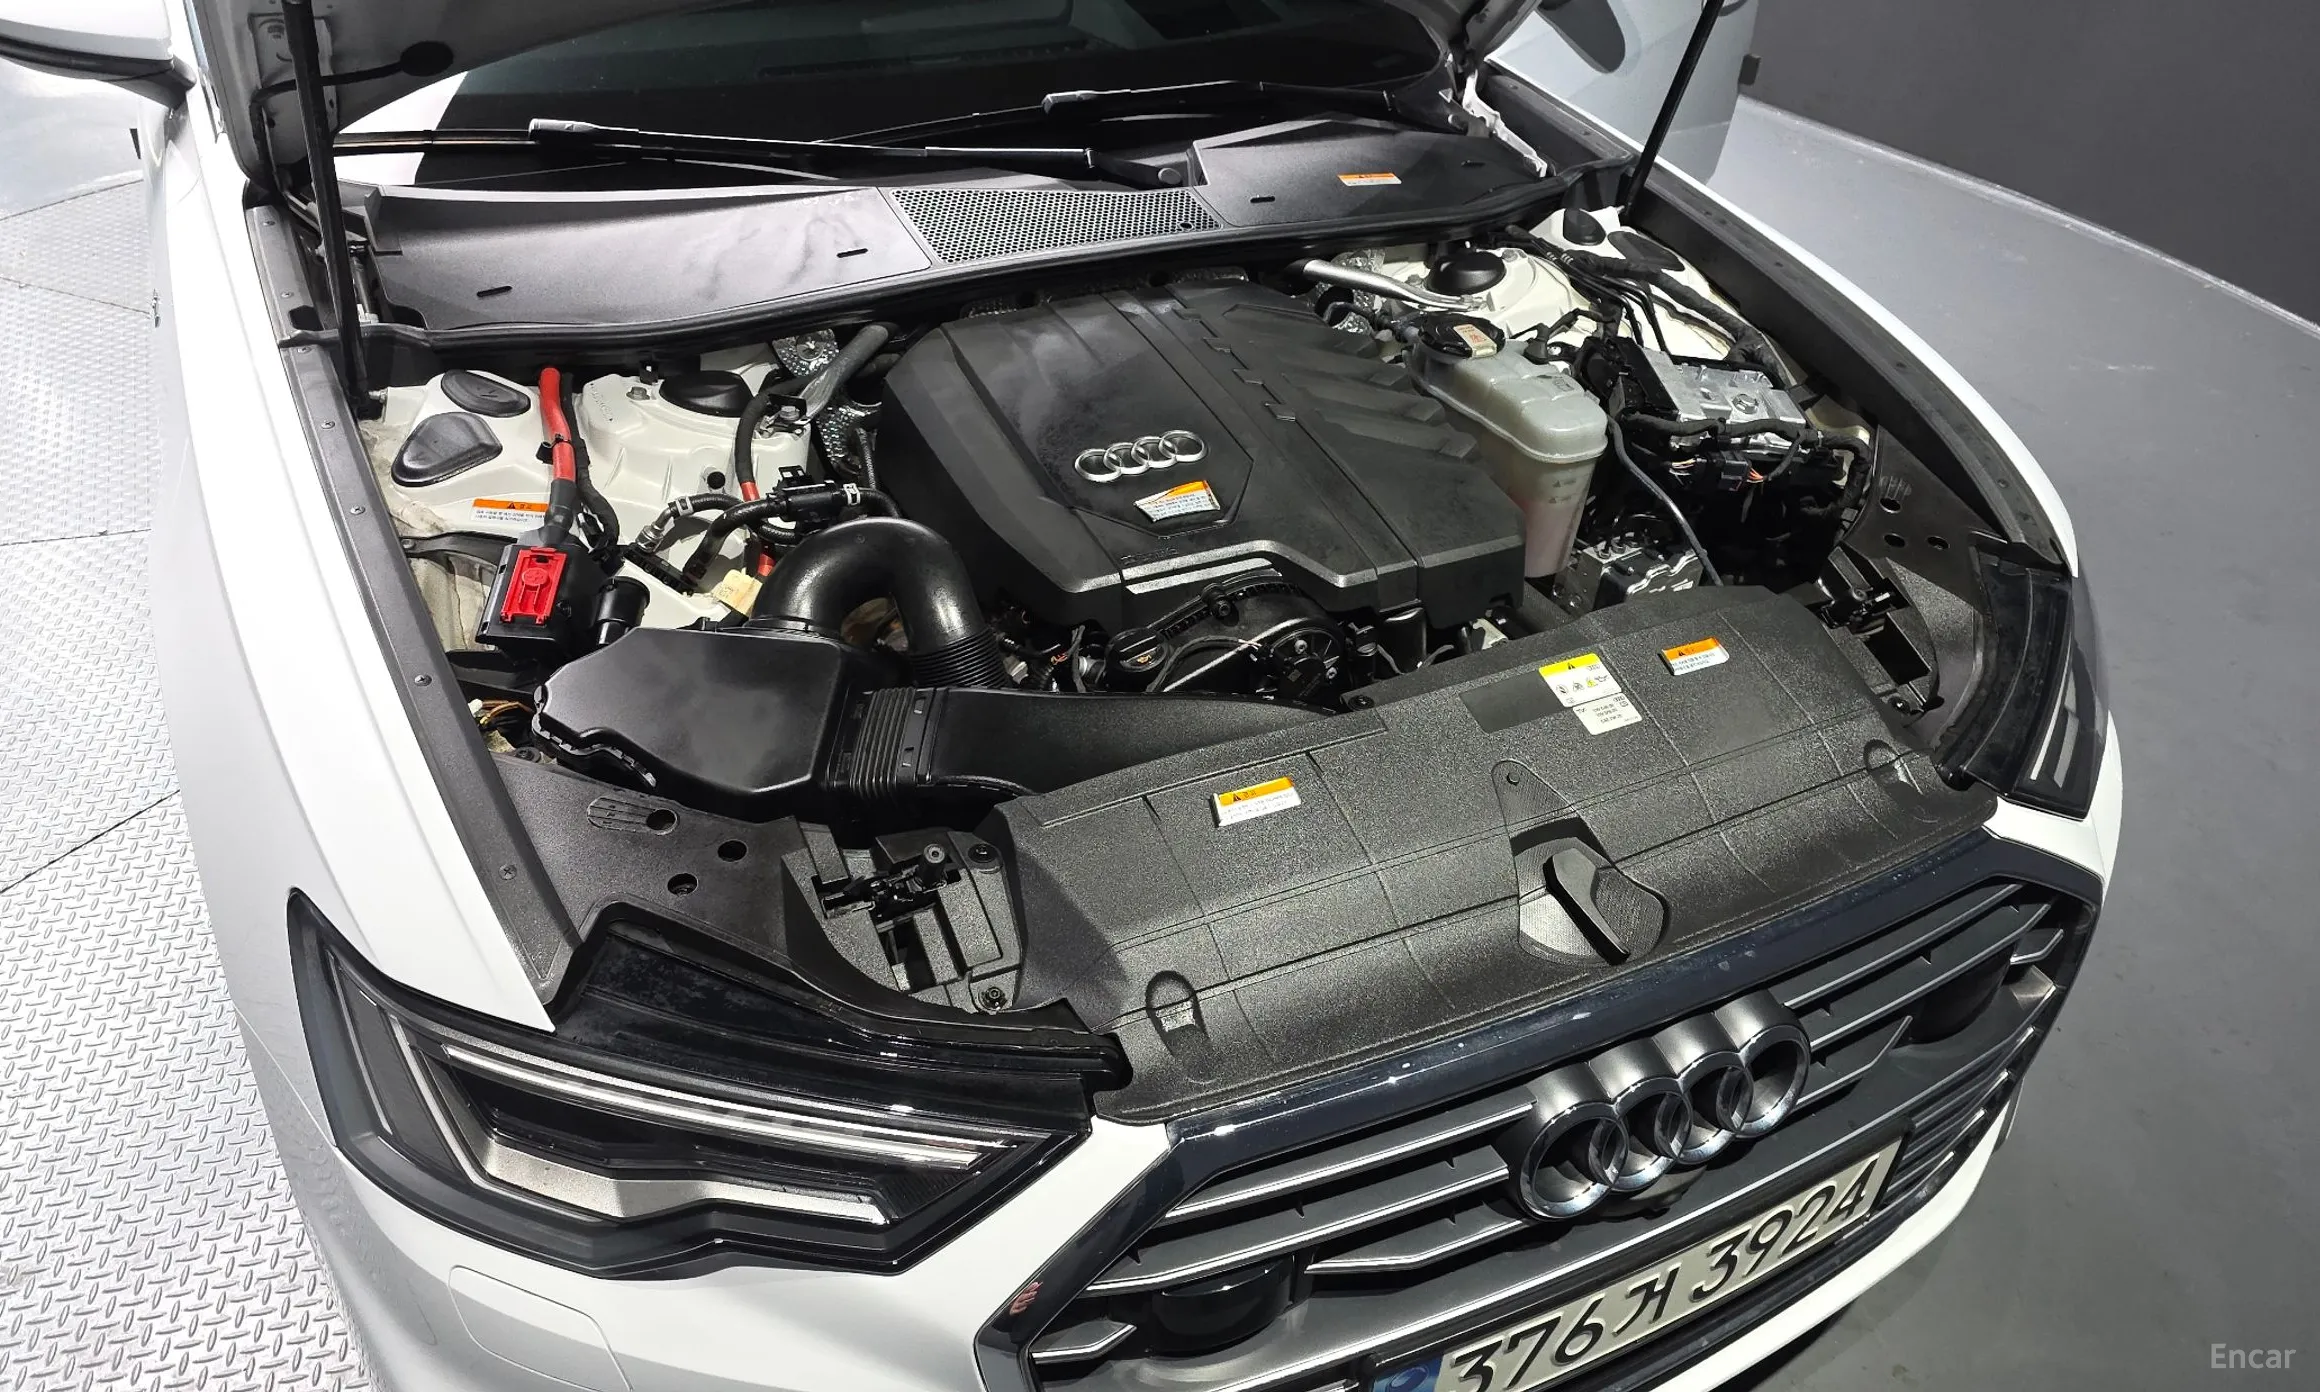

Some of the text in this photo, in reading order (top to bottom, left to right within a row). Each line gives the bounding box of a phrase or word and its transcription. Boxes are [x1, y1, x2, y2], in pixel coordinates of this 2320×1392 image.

[1452, 1155, 1879, 1392] 376 거 3924
